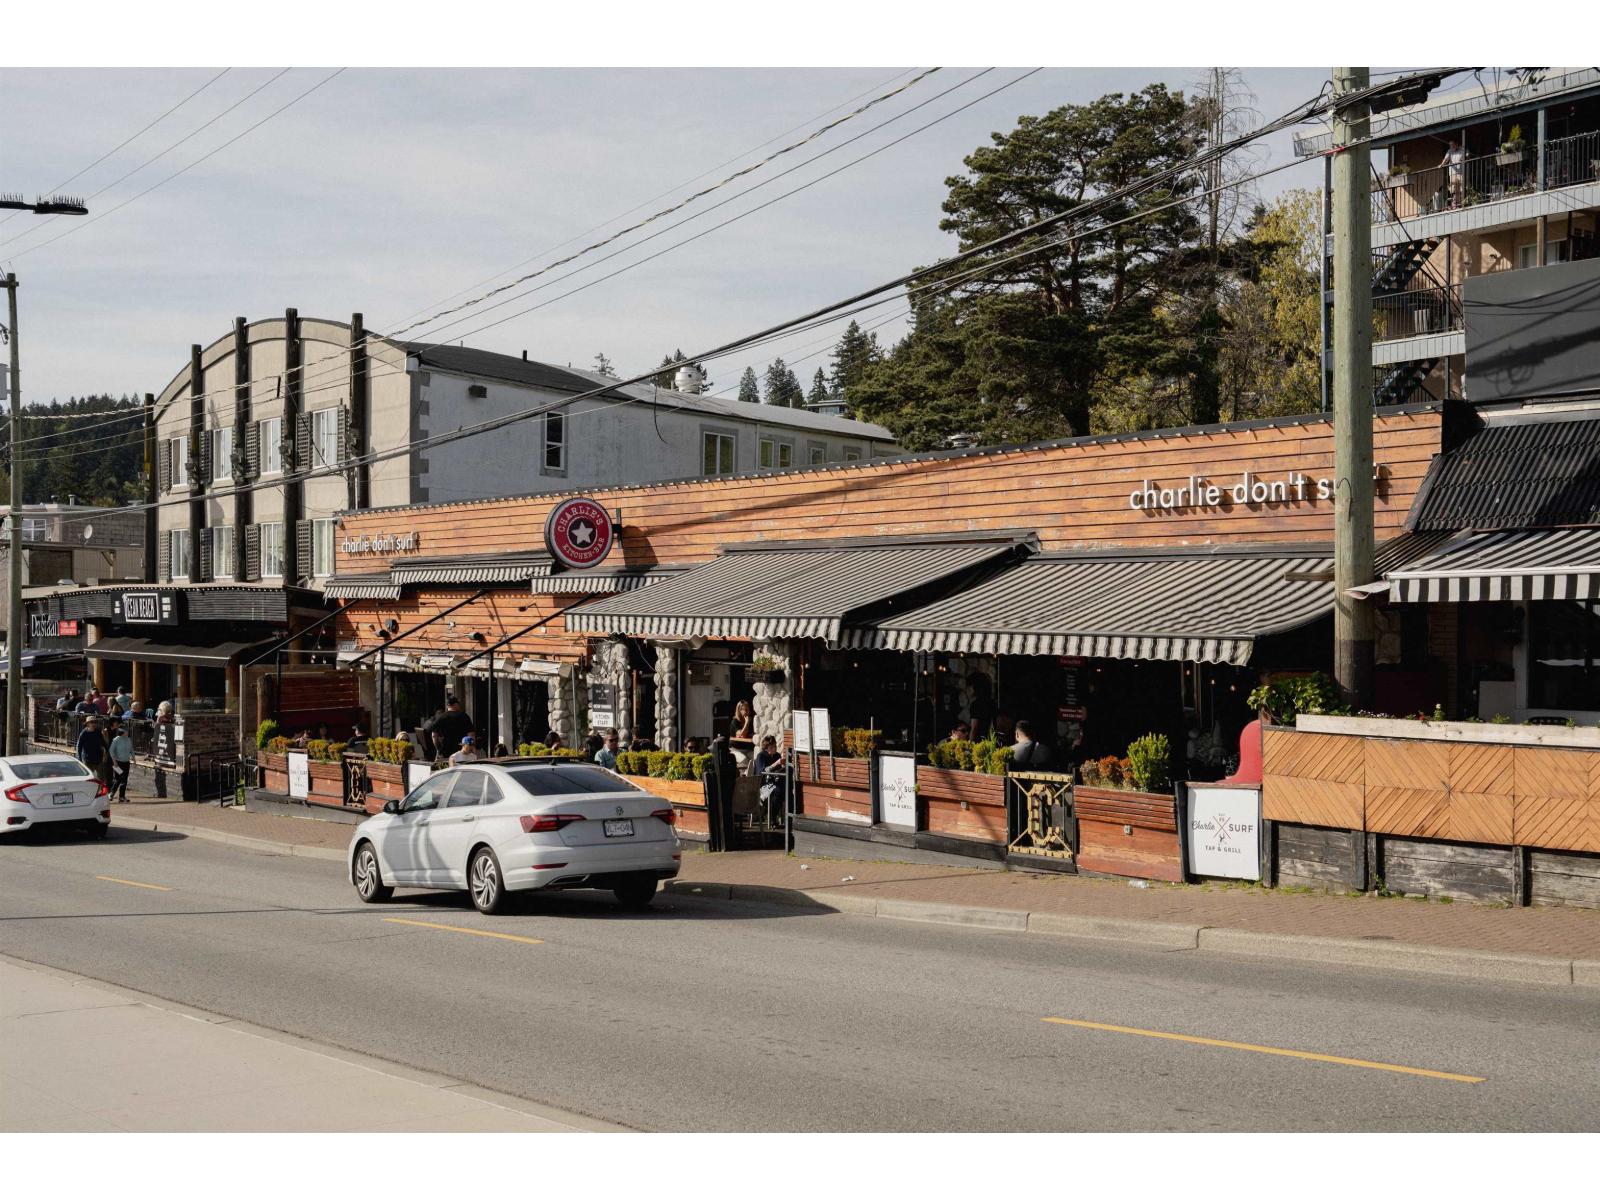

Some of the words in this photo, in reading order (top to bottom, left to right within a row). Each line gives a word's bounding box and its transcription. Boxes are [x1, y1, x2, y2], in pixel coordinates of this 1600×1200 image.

[1129, 475, 1221, 510] charlie
[1233, 471, 1305, 504] don't
[557, 505, 604, 532] CHARLIE'S
[341, 534, 370, 552] charlie
[372, 532, 395, 551] don't
[396, 530, 416, 550] surf
[1192, 819, 1215, 830] Charlie
[1229, 824, 1254, 832] SURF
